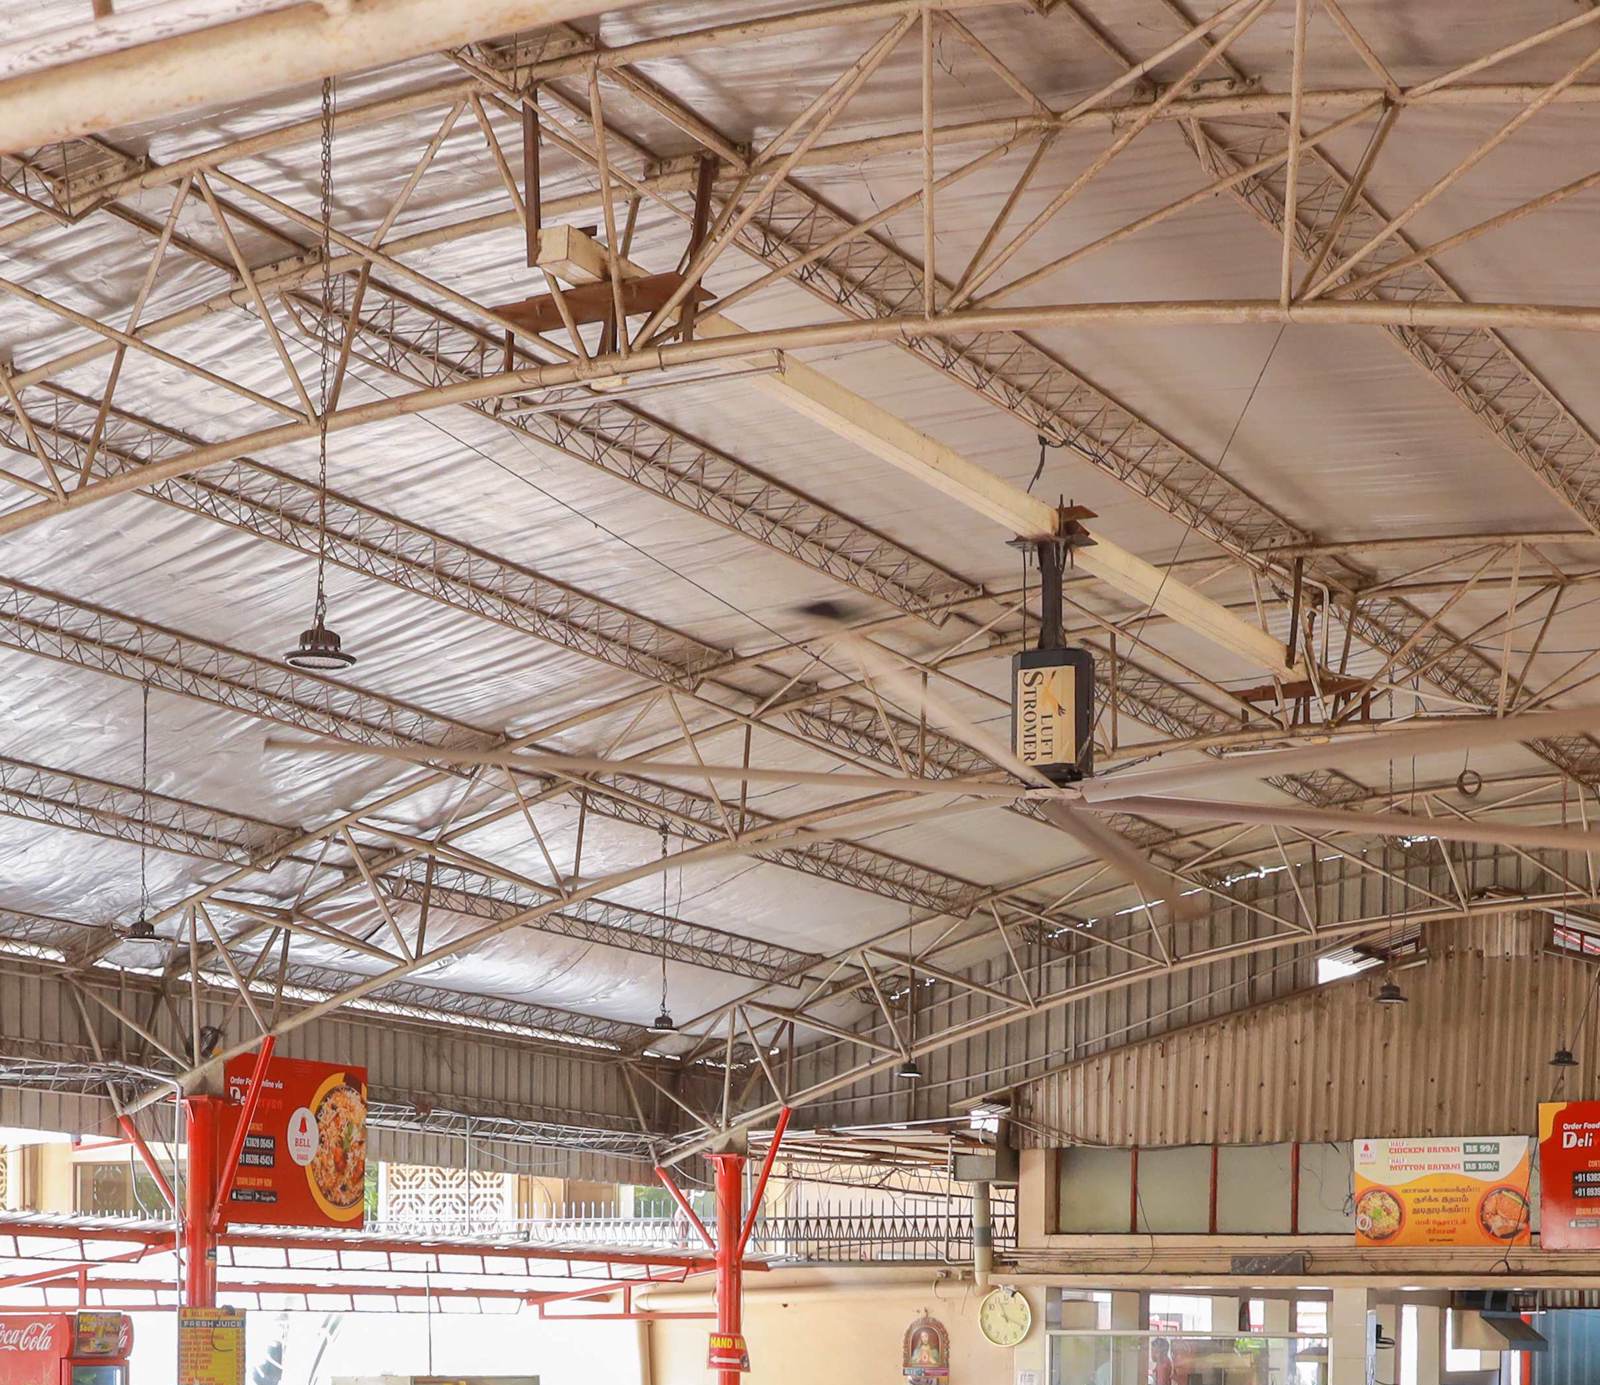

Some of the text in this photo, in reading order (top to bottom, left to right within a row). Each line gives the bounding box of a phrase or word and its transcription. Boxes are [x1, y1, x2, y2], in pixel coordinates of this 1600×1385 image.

[1022, 671, 1044, 762] STROMER
[1041, 715, 1053, 759] LUFT
[1562, 1122, 1582, 1130] Order
[295, 1138, 311, 1147] BELL
[1389, 1146, 1424, 1154] CHICKEN
[710, 1336, 733, 1349] HAND
